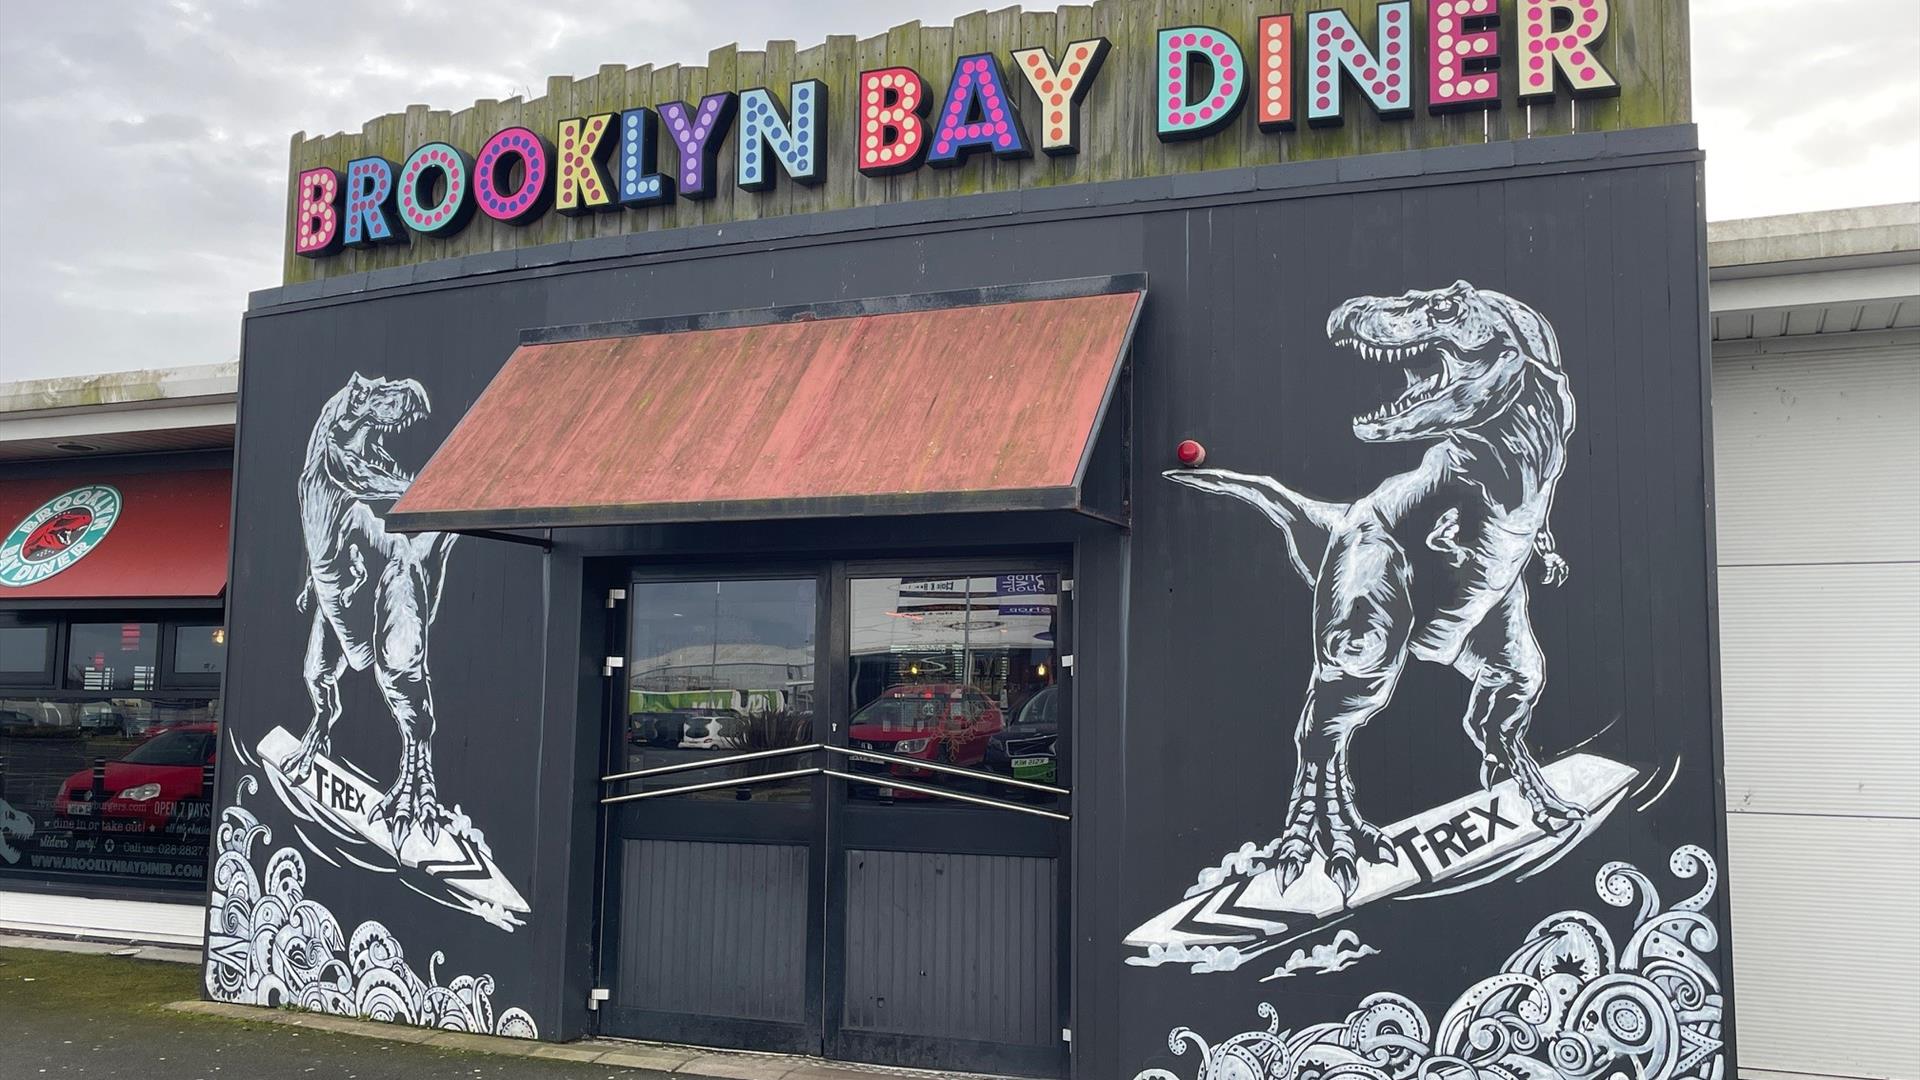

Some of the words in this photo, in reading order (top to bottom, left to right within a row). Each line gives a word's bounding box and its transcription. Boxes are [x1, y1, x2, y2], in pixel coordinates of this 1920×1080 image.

[297, 80, 826, 256] BROOKLYN
[859, 37, 1110, 177] BAY
[1157, 0, 1621, 142] DINER
[20, 489, 114, 533] BROOKLYN
[12, 541, 90, 581] DINER
[154, 801, 177, 817] OPEN
[187, 802, 210, 817] DAYS
[313, 761, 366, 815] T-REX
[53, 818, 74, 829] dine
[89, 821, 100, 831] or
[102, 820, 123, 832] take
[1392, 796, 1520, 882] T-REX
[30, 855, 203, 877] WWW.BROOKLYNBAYDINER.COM
